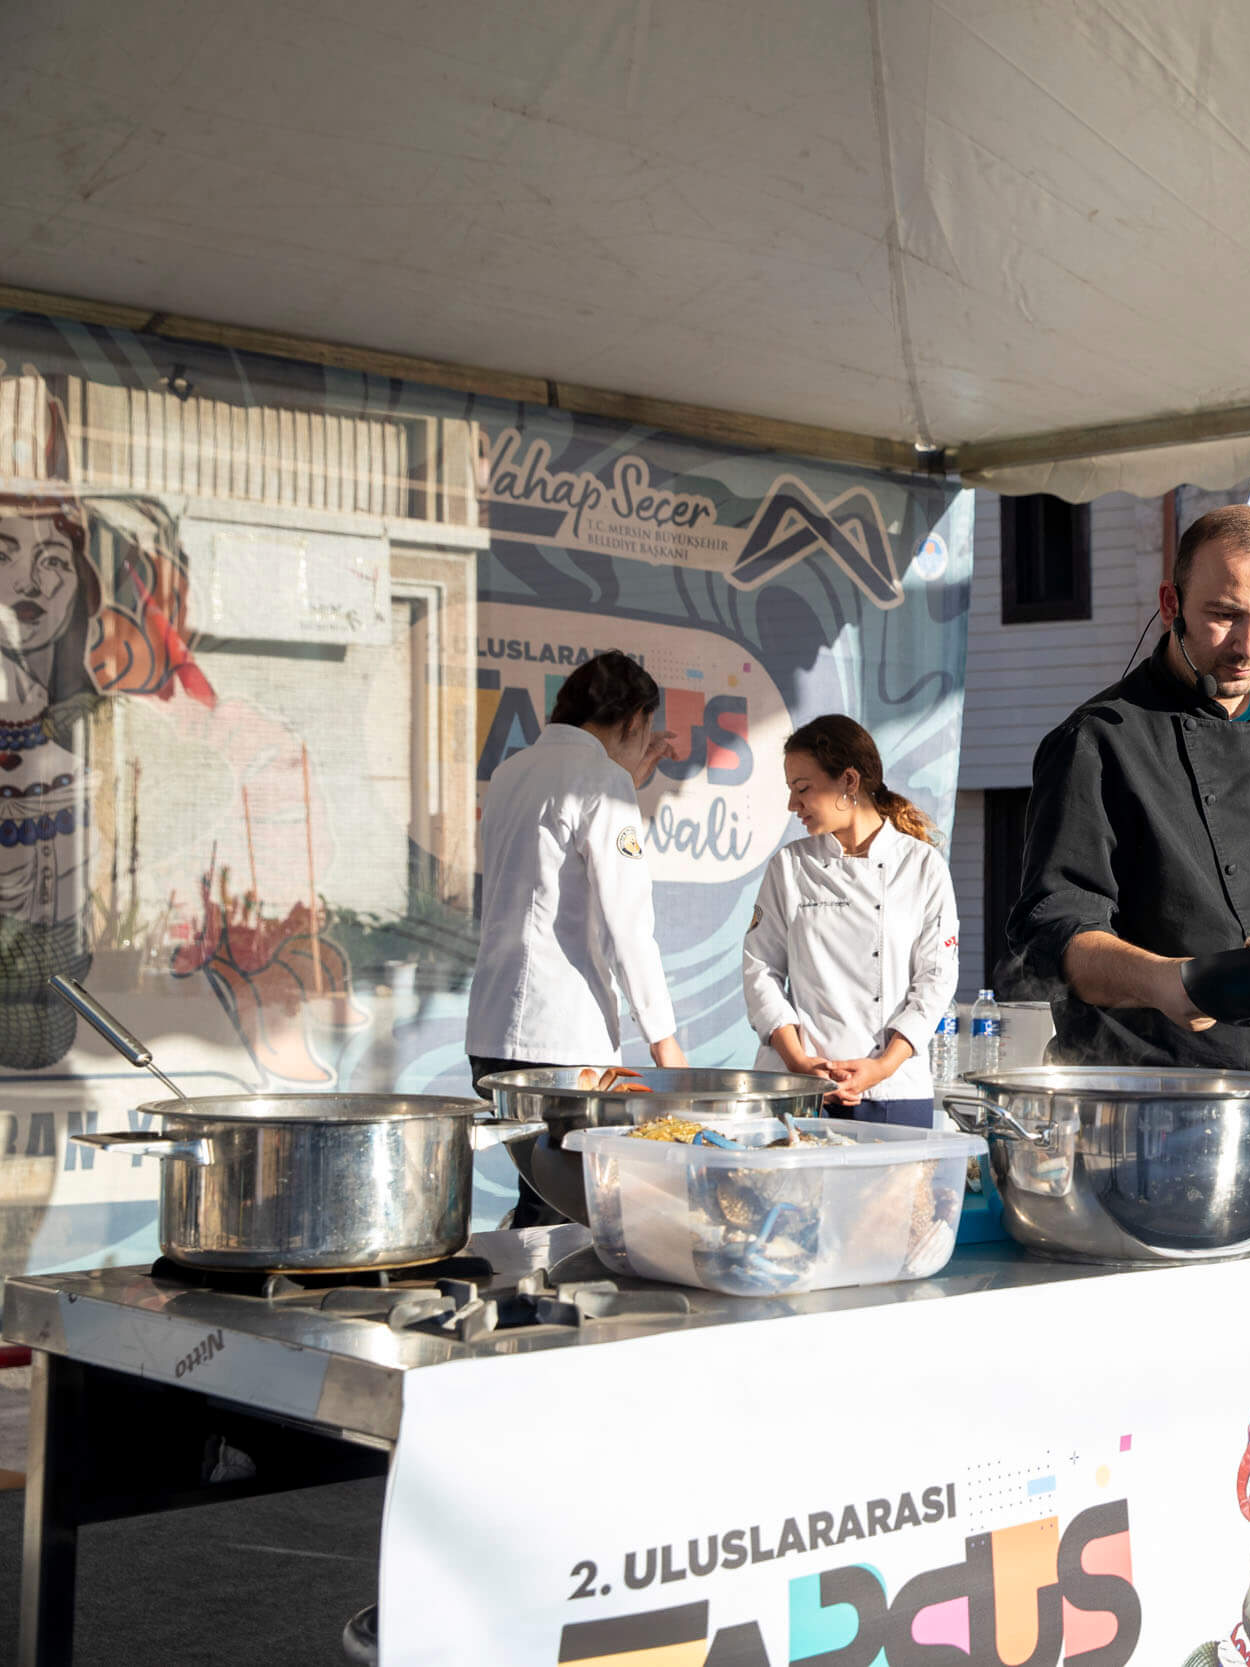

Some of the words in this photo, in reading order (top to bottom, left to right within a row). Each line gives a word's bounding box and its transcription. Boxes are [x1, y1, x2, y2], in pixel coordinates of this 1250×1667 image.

[612, 463, 711, 527] Seçer
[567, 1560, 612, 1601] 2.
[622, 1482, 957, 1590] ULUSLARARASI
